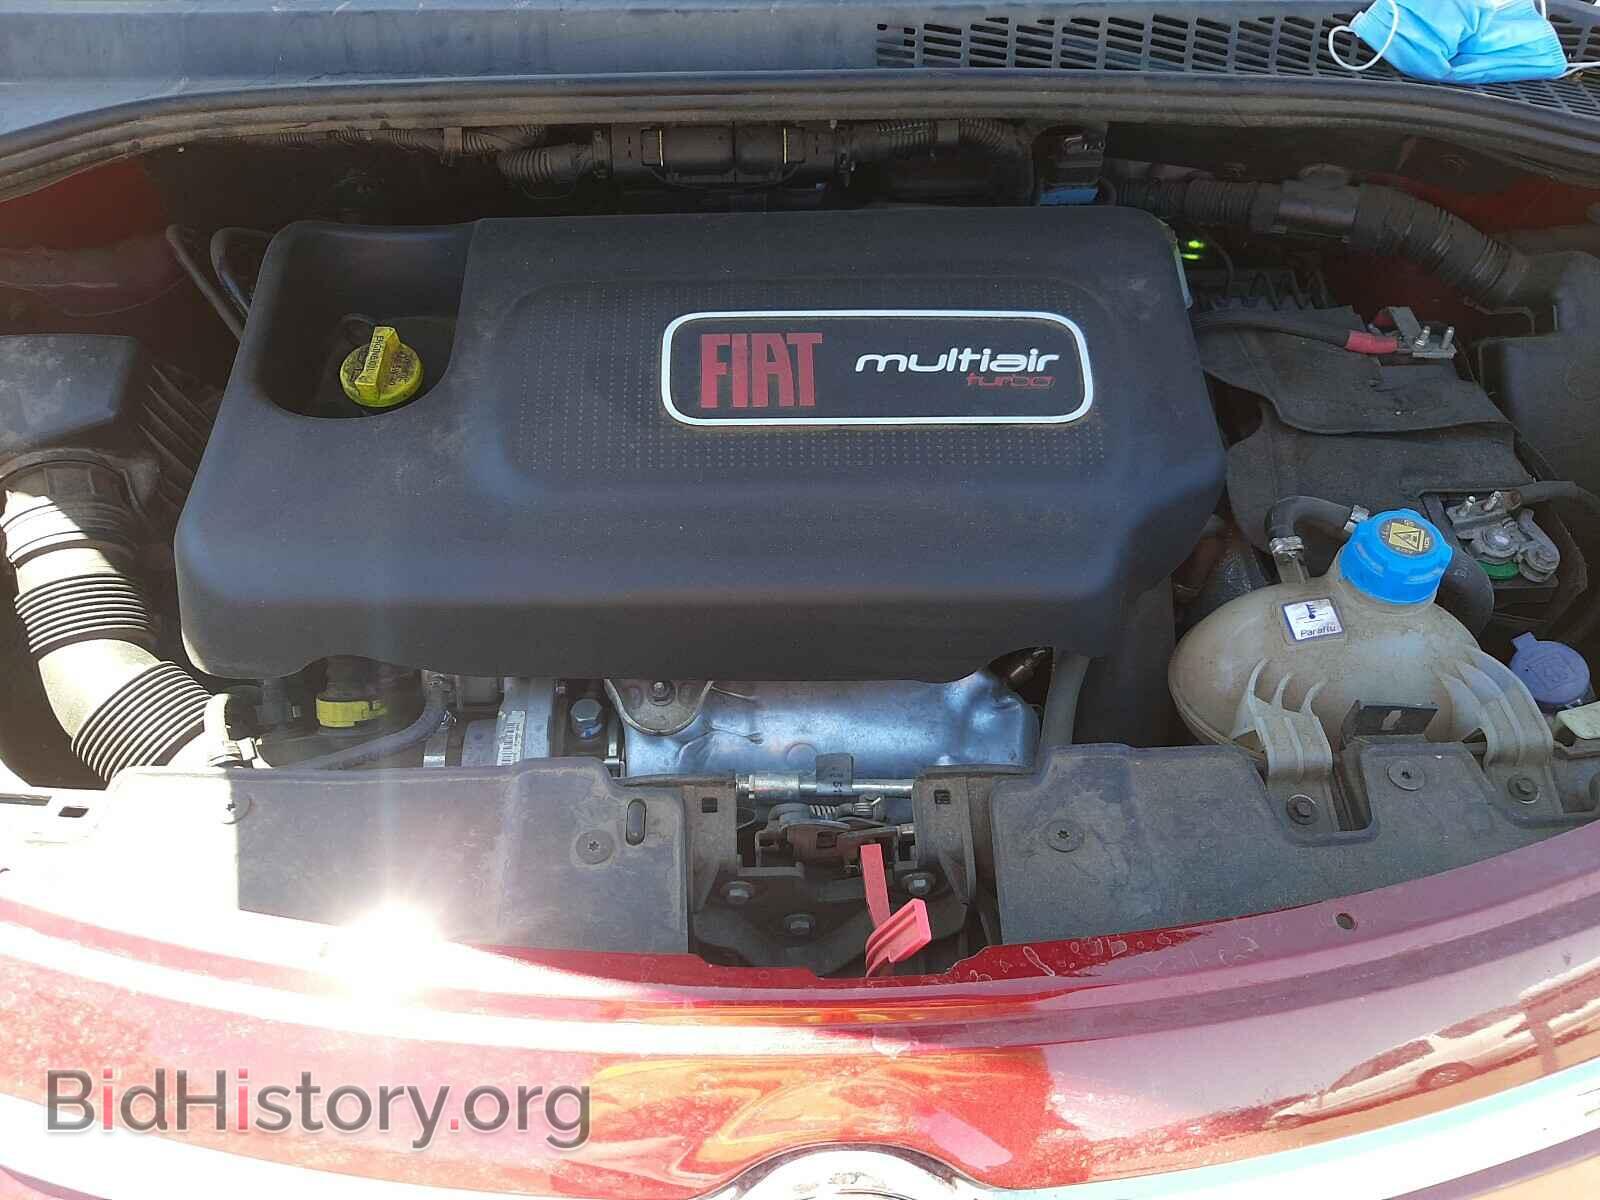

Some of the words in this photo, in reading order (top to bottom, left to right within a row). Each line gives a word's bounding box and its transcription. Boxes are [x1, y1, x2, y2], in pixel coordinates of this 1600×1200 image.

[700, 332, 823, 409] FIAT
[855, 347, 1060, 373] multiair
[1300, 625, 1337, 638] Paraflu
